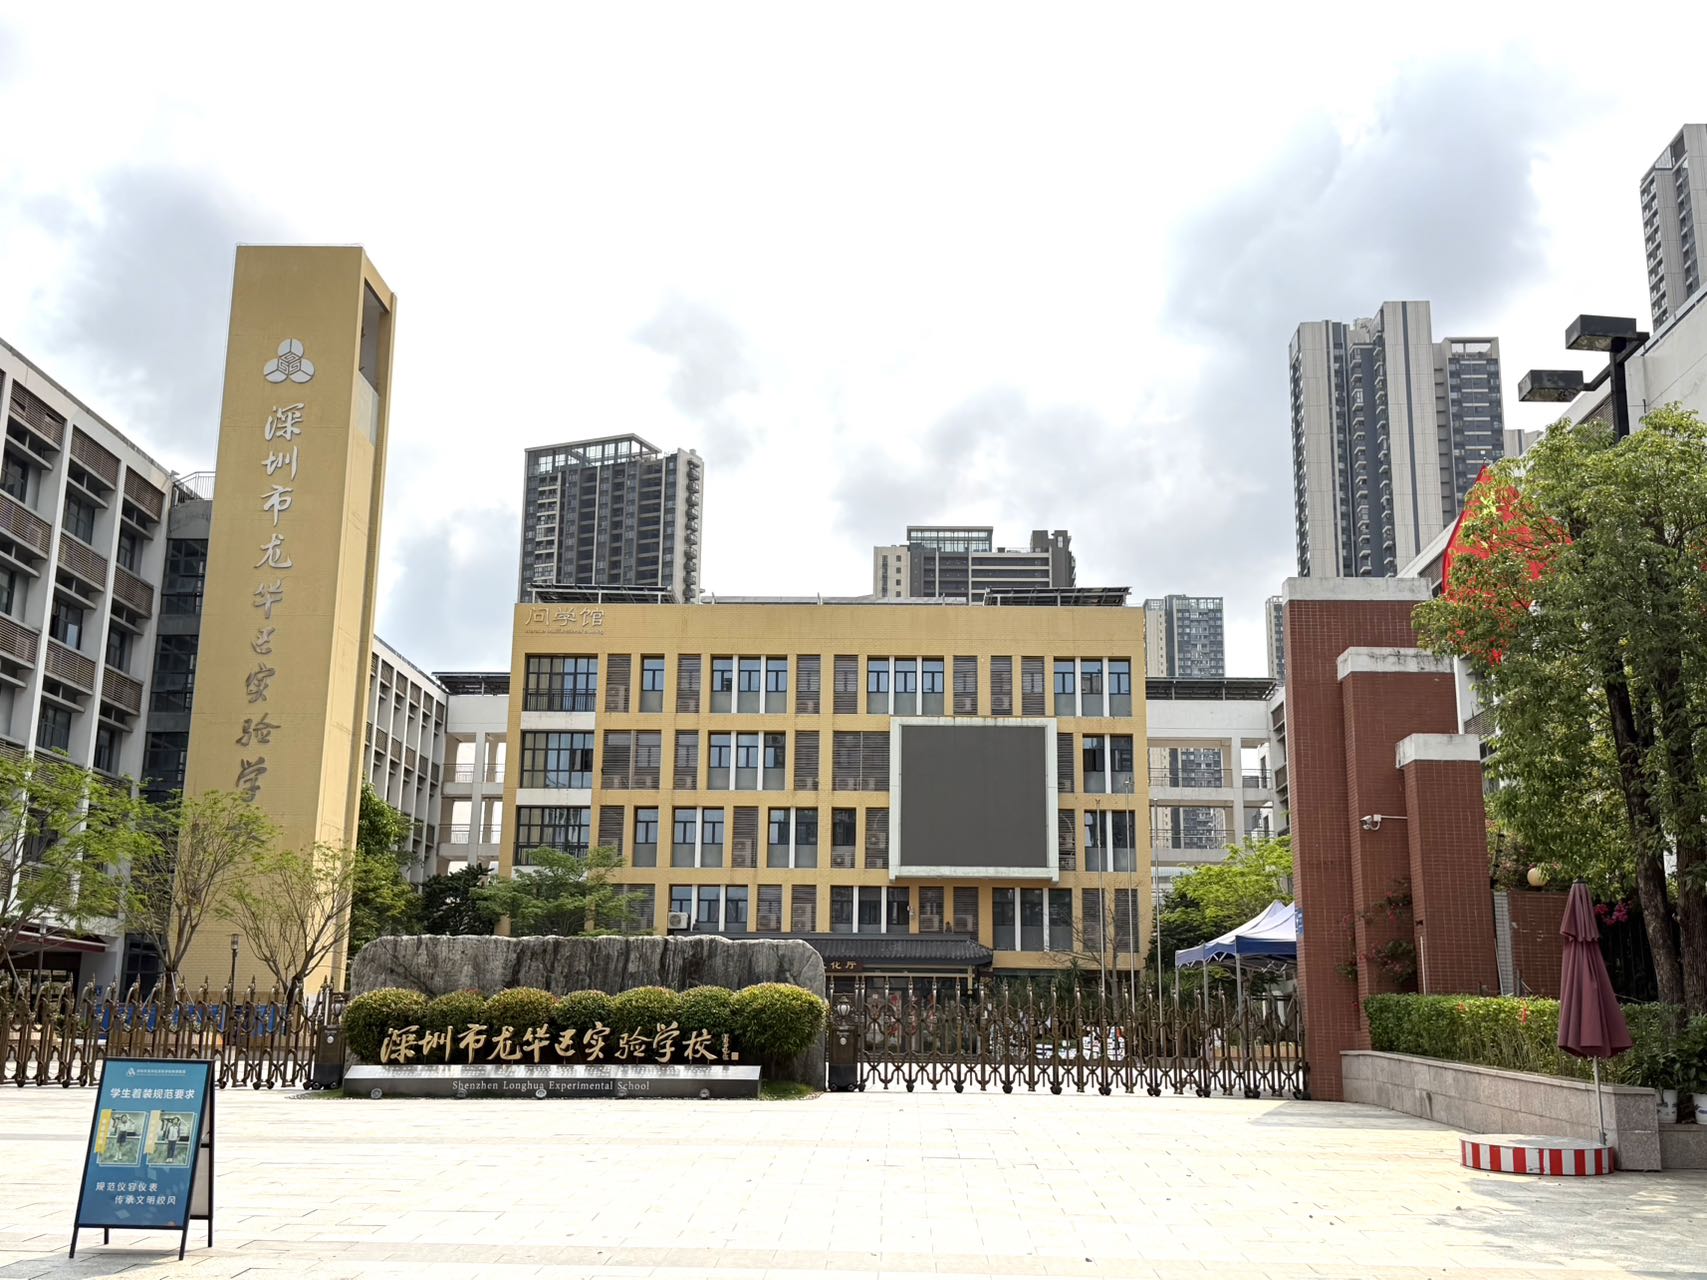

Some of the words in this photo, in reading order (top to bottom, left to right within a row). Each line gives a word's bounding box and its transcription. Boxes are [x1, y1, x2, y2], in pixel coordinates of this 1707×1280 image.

[380, 1021, 718, 1064] 深圳市龙华区实验学校
[452, 1080, 498, 1090] Shenzhen
[503, 1080, 544, 1091] Longhua
[549, 1080, 613, 1092] Experimental
[617, 1080, 650, 1090] School
[110, 1087, 195, 1099] 学生着装规范要求
[95, 1181, 158, 1192] 规范仪容仪表
[114, 1194, 176, 1205] 传承文明校风
